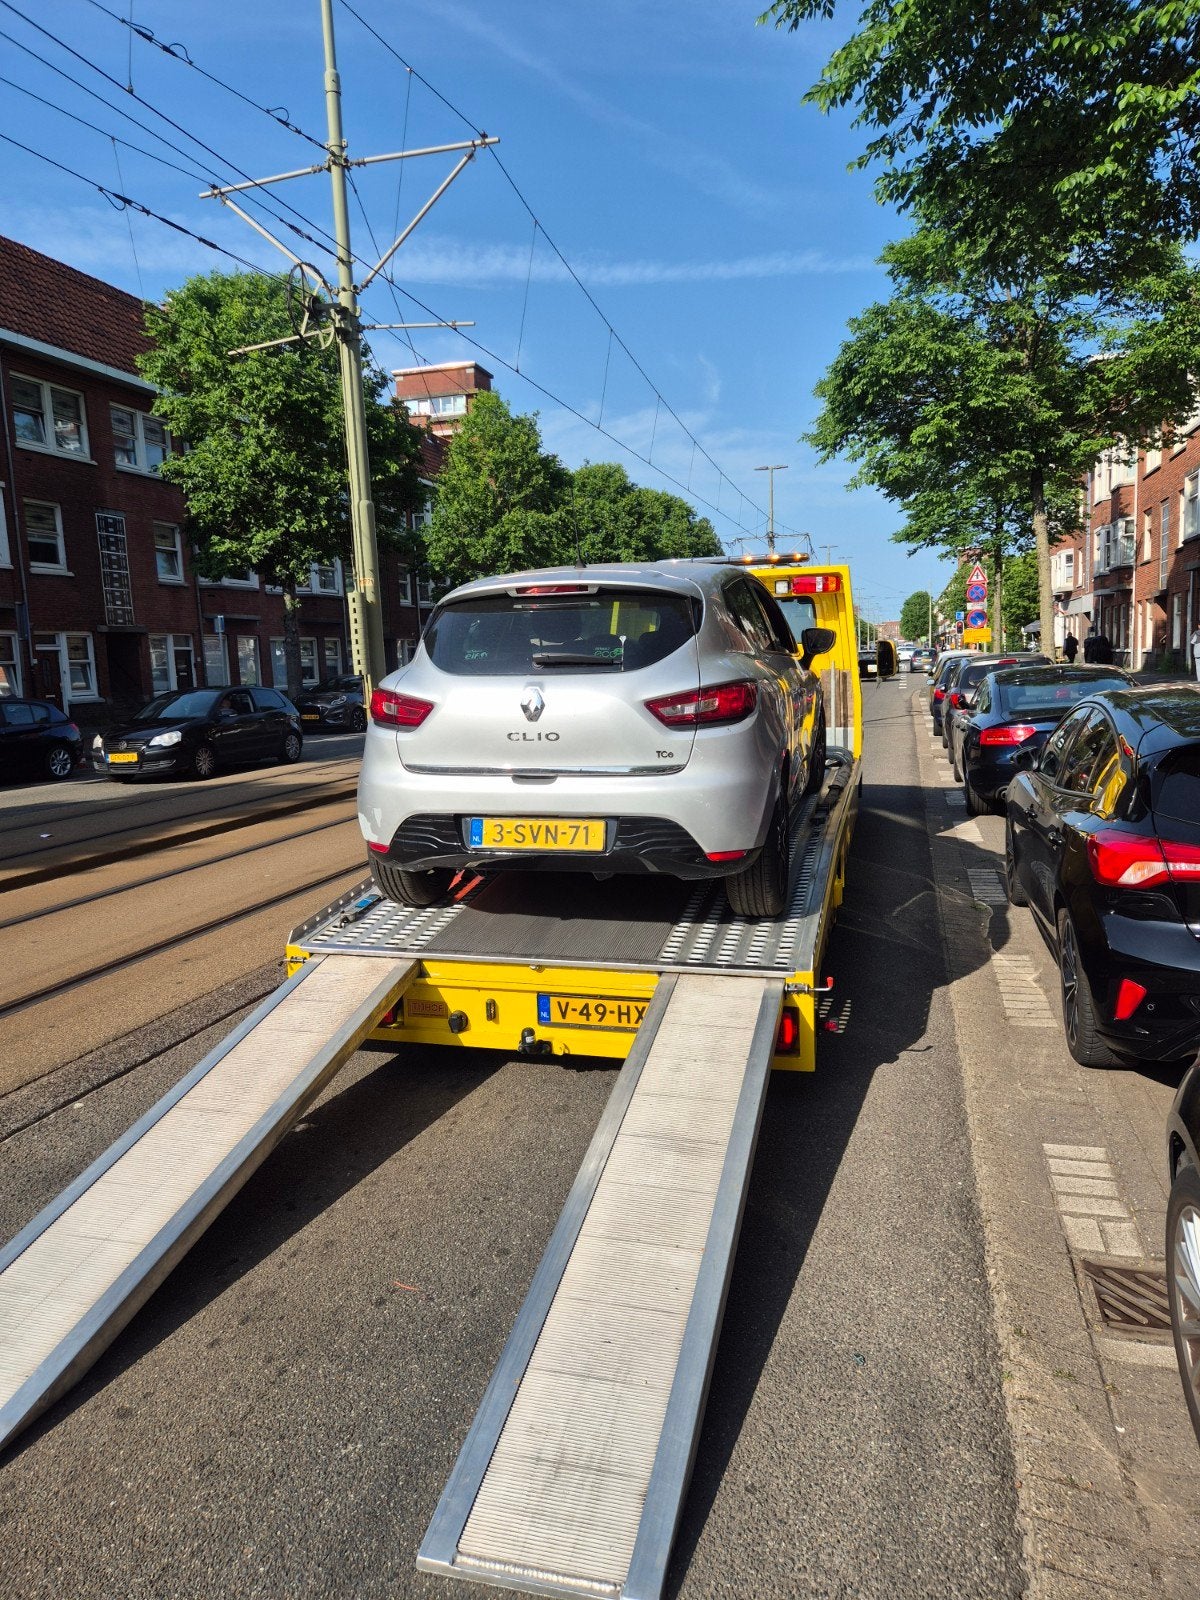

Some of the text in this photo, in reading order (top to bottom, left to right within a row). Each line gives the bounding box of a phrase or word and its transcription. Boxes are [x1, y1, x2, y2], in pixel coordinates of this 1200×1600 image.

[507, 732, 560, 742] CLIO
[656, 750, 674, 759] TCe
[492, 824, 589, 845] 3-SVN-71
[557, 1001, 647, 1025] V-49-HX
